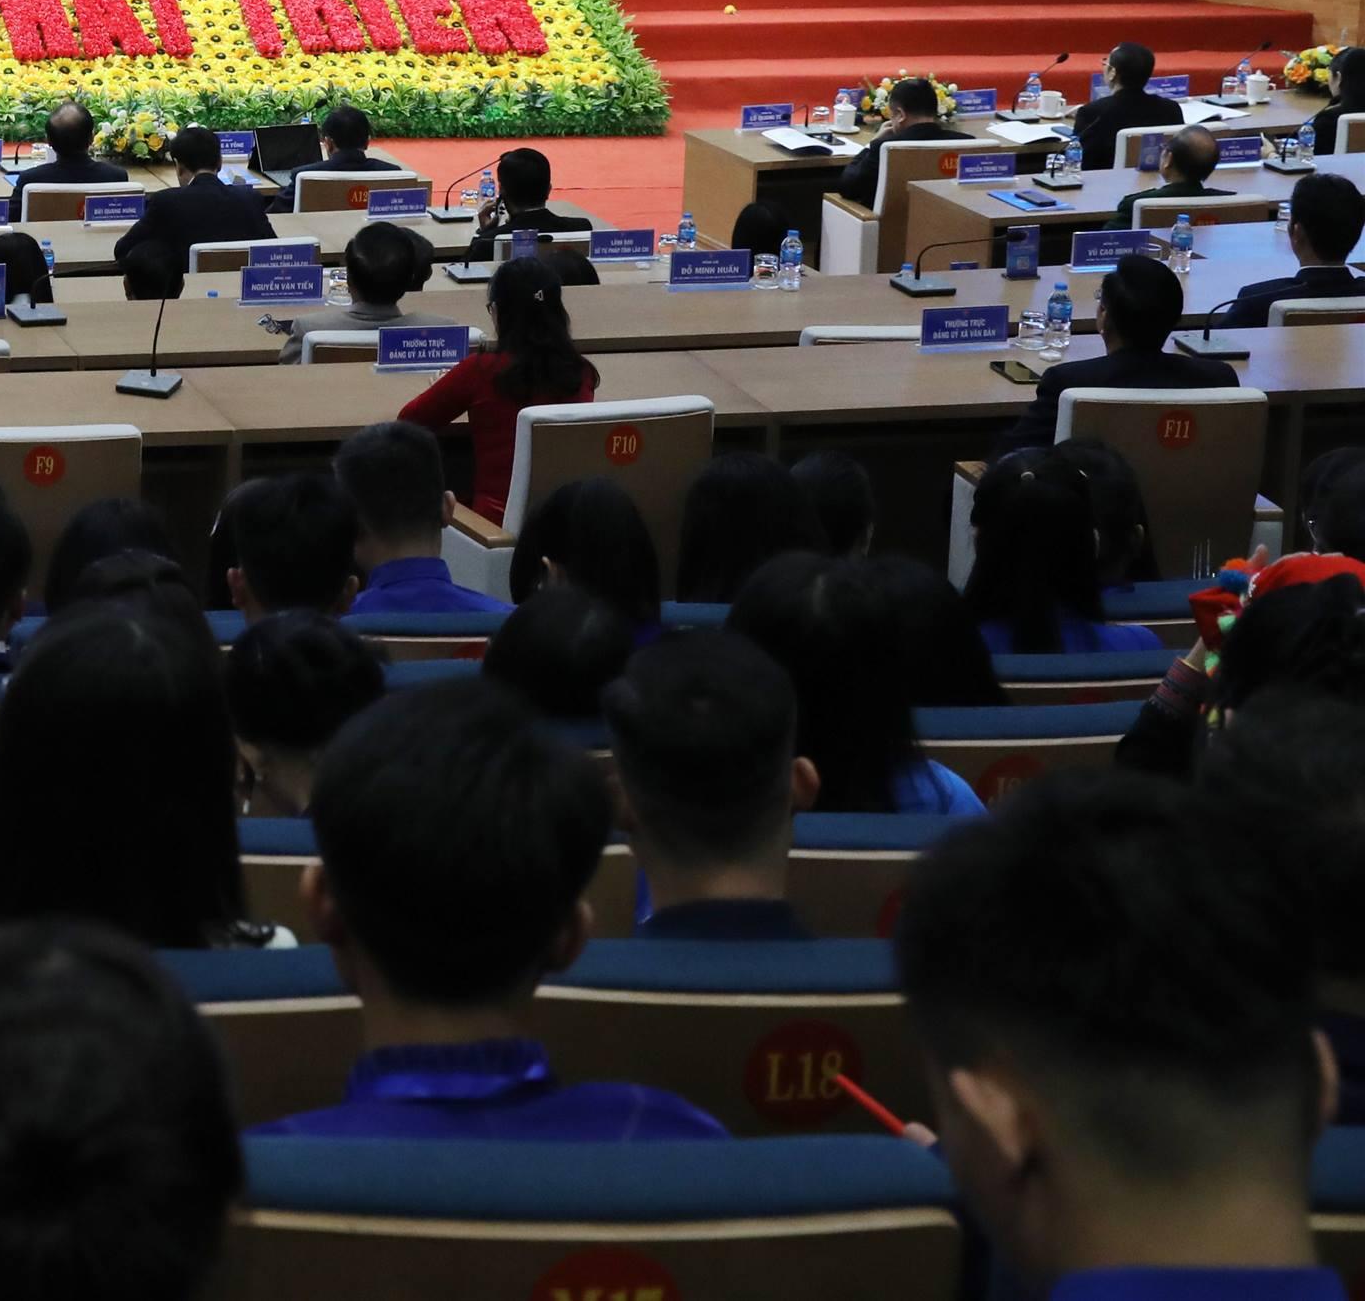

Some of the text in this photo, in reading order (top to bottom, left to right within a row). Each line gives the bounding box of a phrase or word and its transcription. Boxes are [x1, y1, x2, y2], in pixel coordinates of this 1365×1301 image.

[1164, 419, 1189, 439] F11
[611, 435, 637, 454] F10
[35, 456, 54, 475] F9
[765, 1050, 842, 1102] L18
